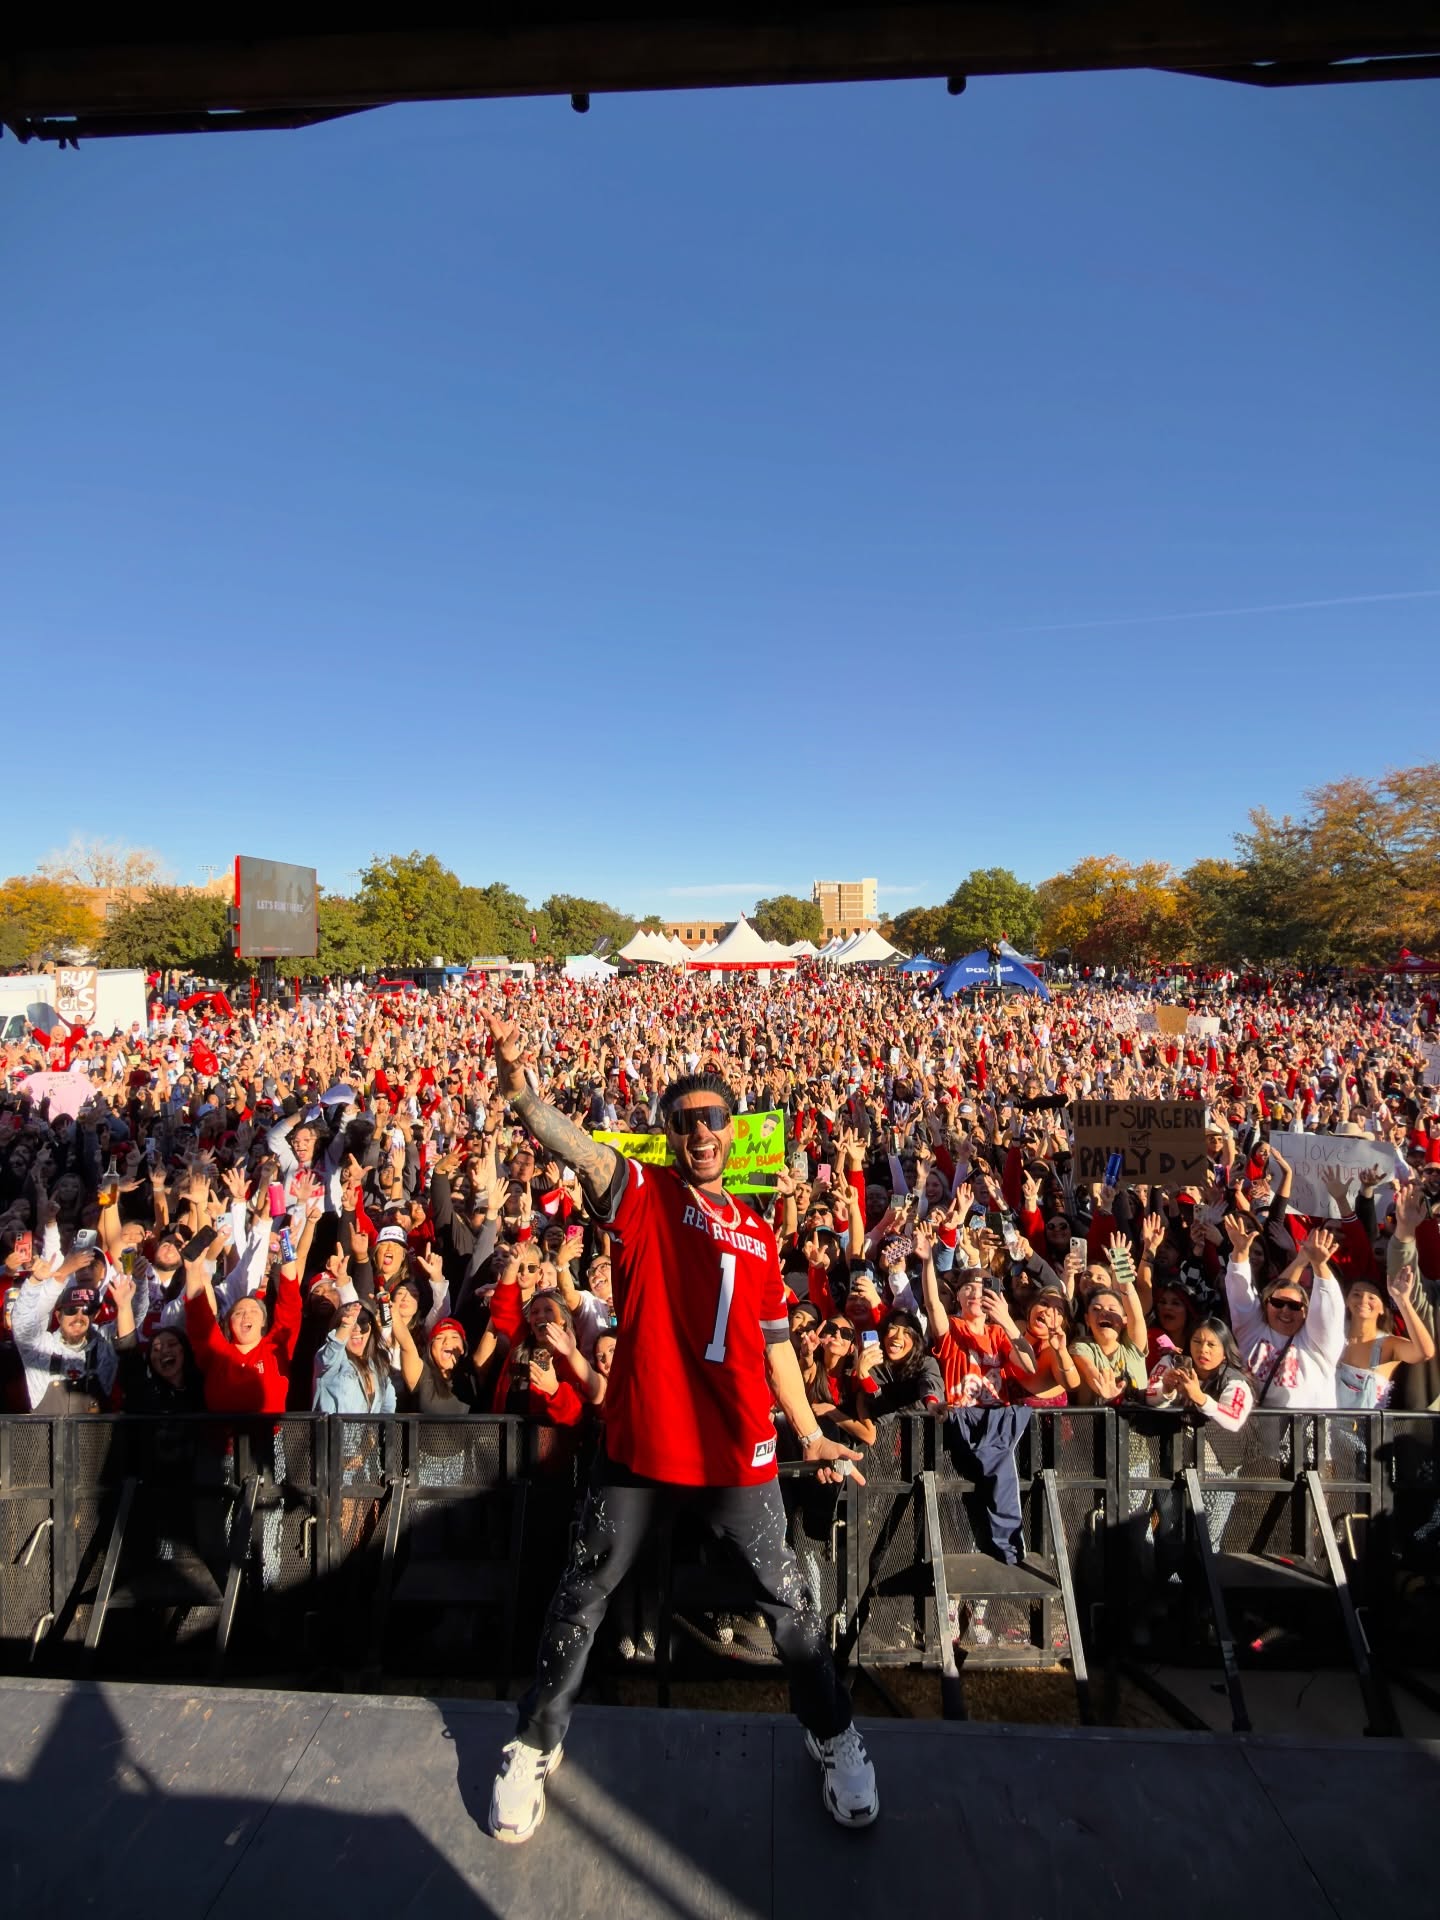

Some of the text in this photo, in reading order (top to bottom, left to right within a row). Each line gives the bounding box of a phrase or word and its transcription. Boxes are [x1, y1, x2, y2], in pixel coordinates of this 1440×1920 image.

[60, 970, 95, 990] BUY
[58, 987, 95, 1011] GAS
[1077, 1104, 1206, 1129] HIP SURGERY
[704, 1252, 737, 1364] 1
